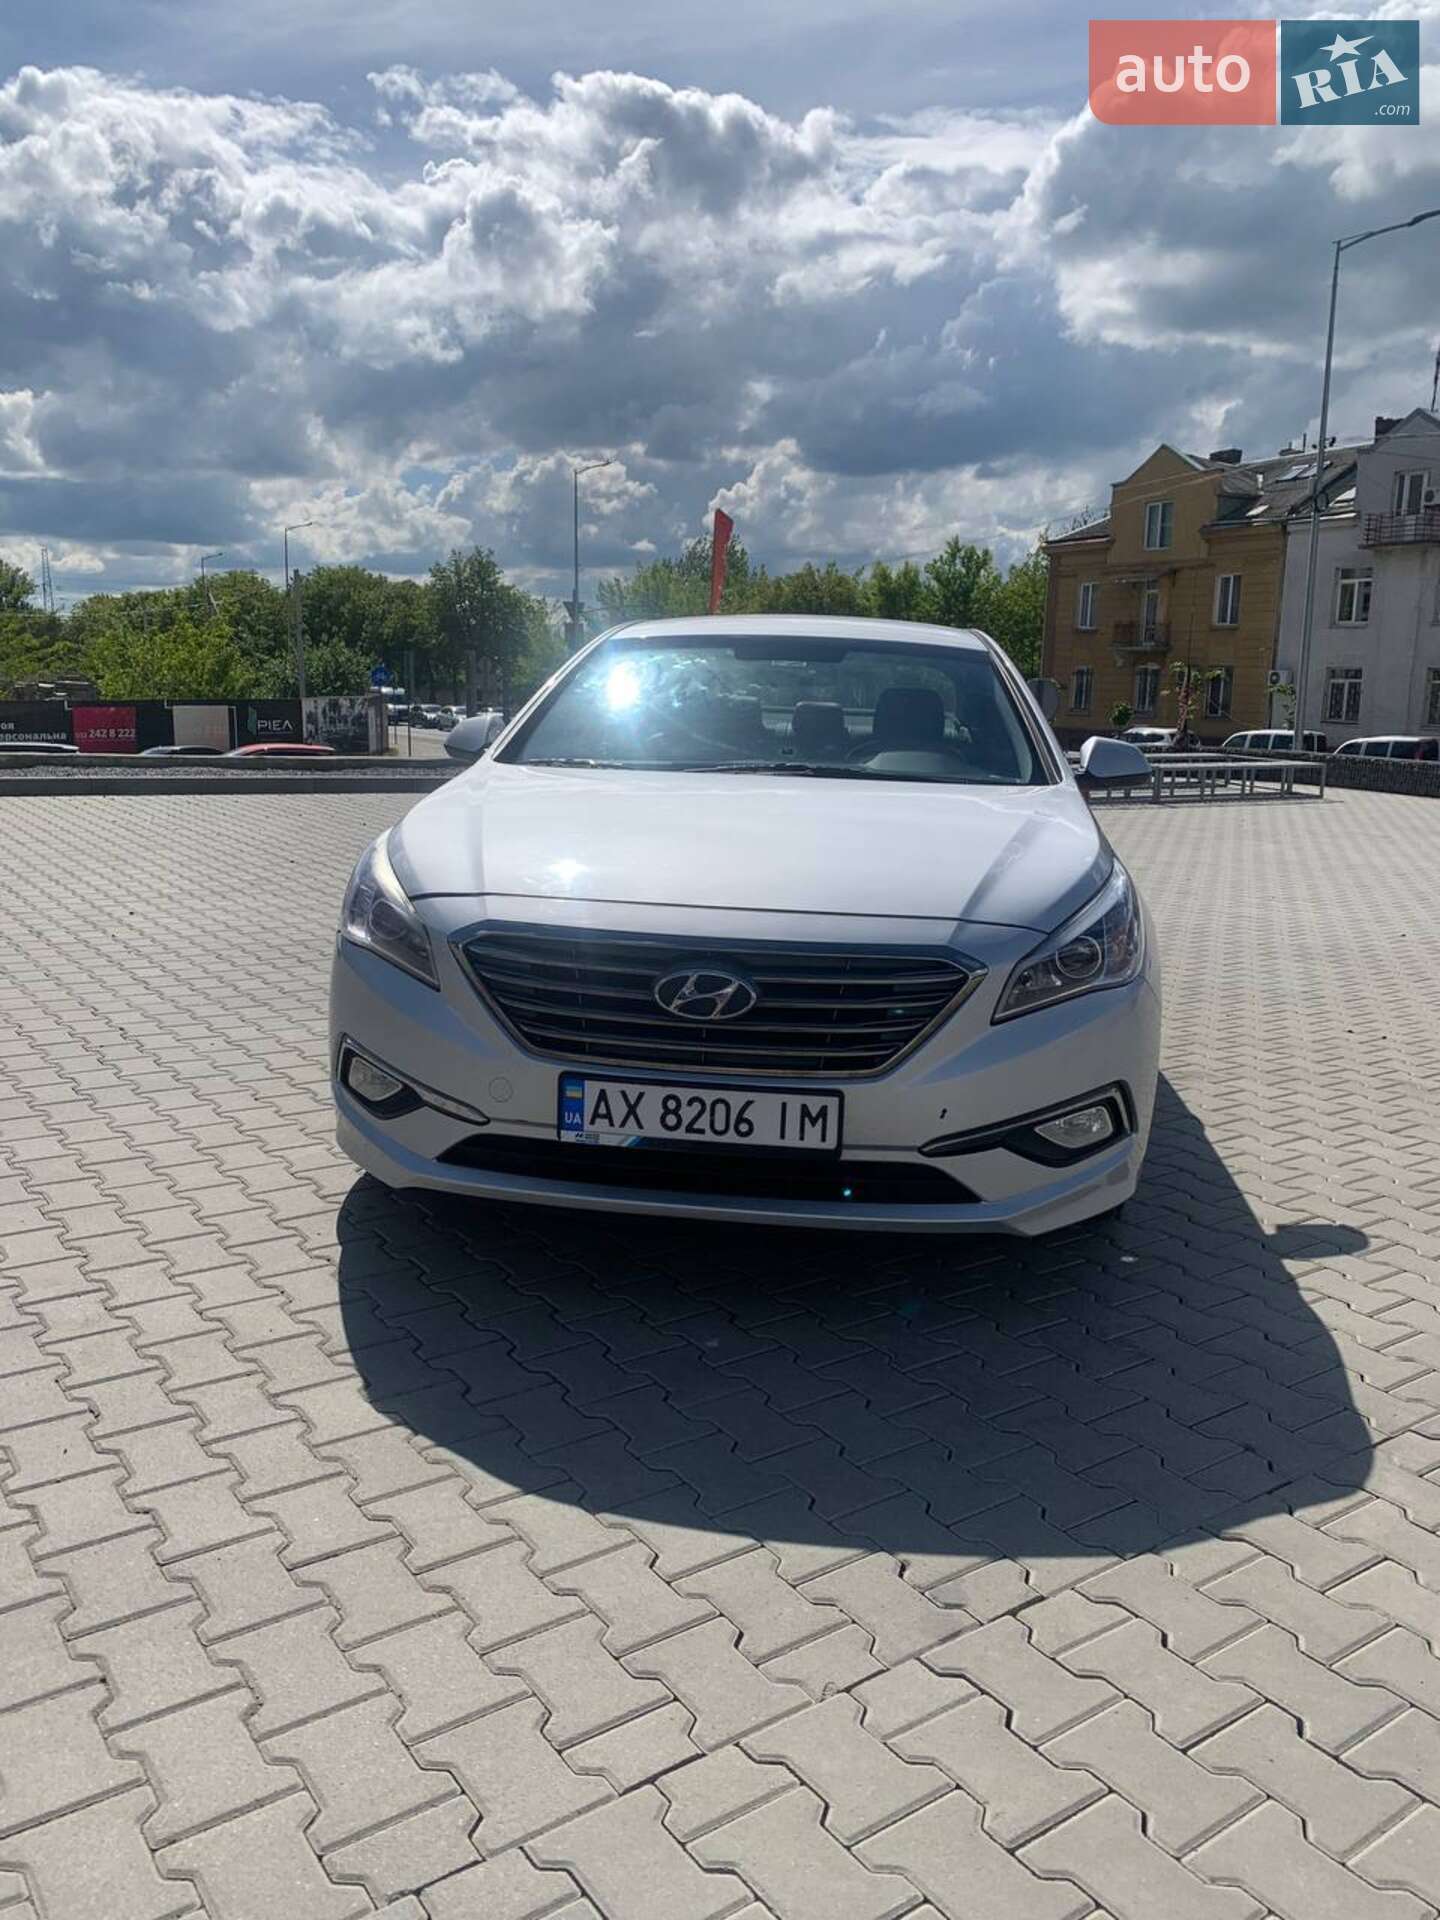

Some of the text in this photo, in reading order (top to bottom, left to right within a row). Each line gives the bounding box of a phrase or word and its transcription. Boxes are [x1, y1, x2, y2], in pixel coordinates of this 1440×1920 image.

[564, 1111, 582, 1124] UA
[588, 1088, 830, 1143] AX 8206 IM
